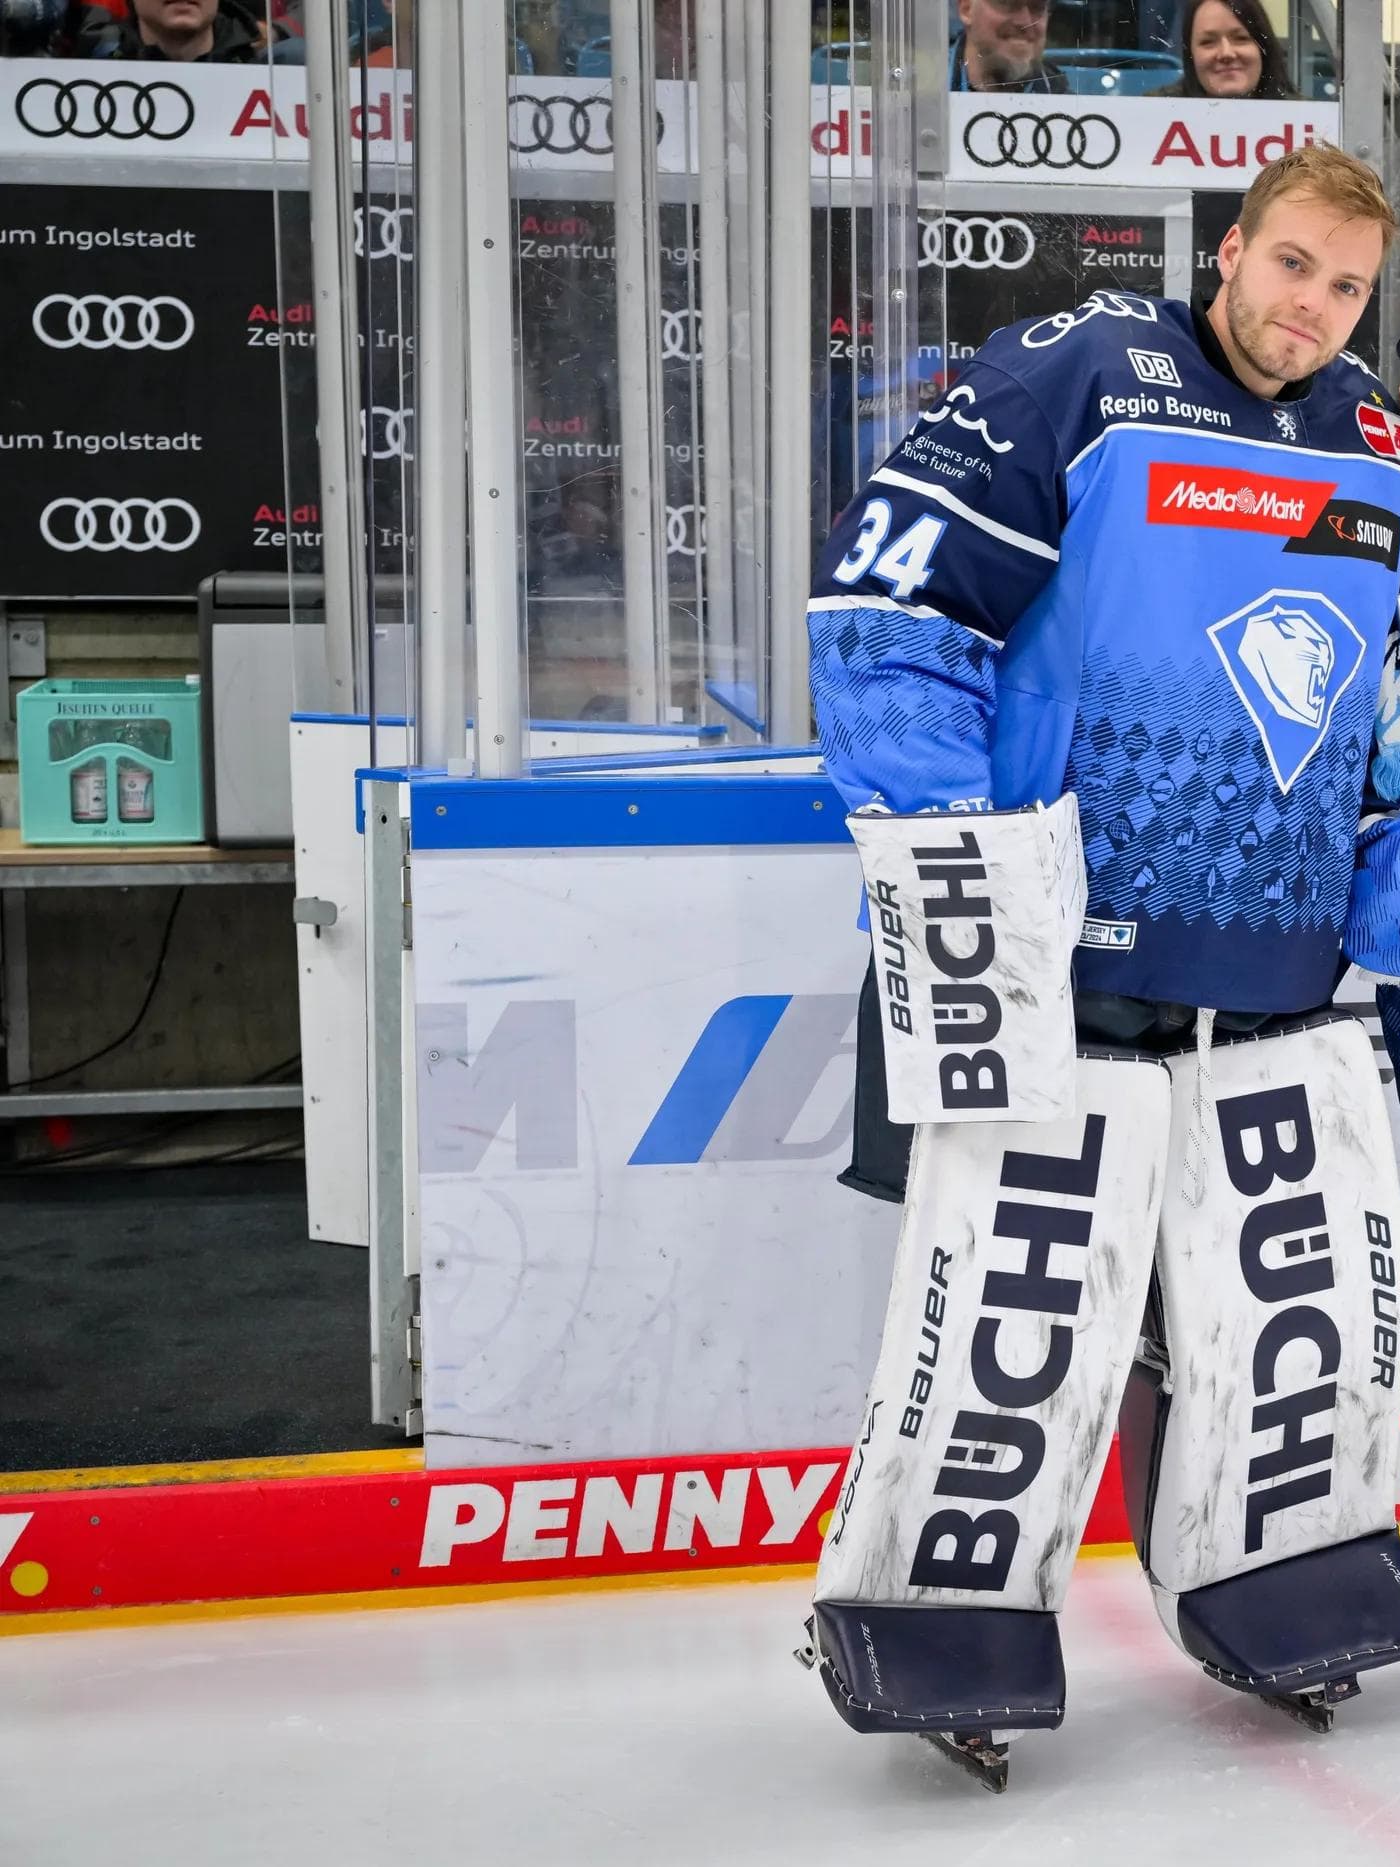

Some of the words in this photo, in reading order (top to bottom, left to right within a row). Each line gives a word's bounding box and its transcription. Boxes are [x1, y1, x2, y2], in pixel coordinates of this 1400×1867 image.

[46, 225, 196, 251] Ingolstadt
[1082, 226, 1142, 245] Audi
[1137, 355, 1174, 381] DB
[1100, 393, 1159, 419] Regio
[1166, 397, 1232, 427] Bayern
[53, 430, 202, 454] Ingolstadt
[929, 456, 966, 479] future
[964, 457, 980, 469] of
[832, 498, 948, 600] 34
[910, 831, 1009, 1109] BÜCHL
[1216, 1083, 1341, 1555] BÜCHL
[908, 1113, 1106, 1592] BÜCHL
